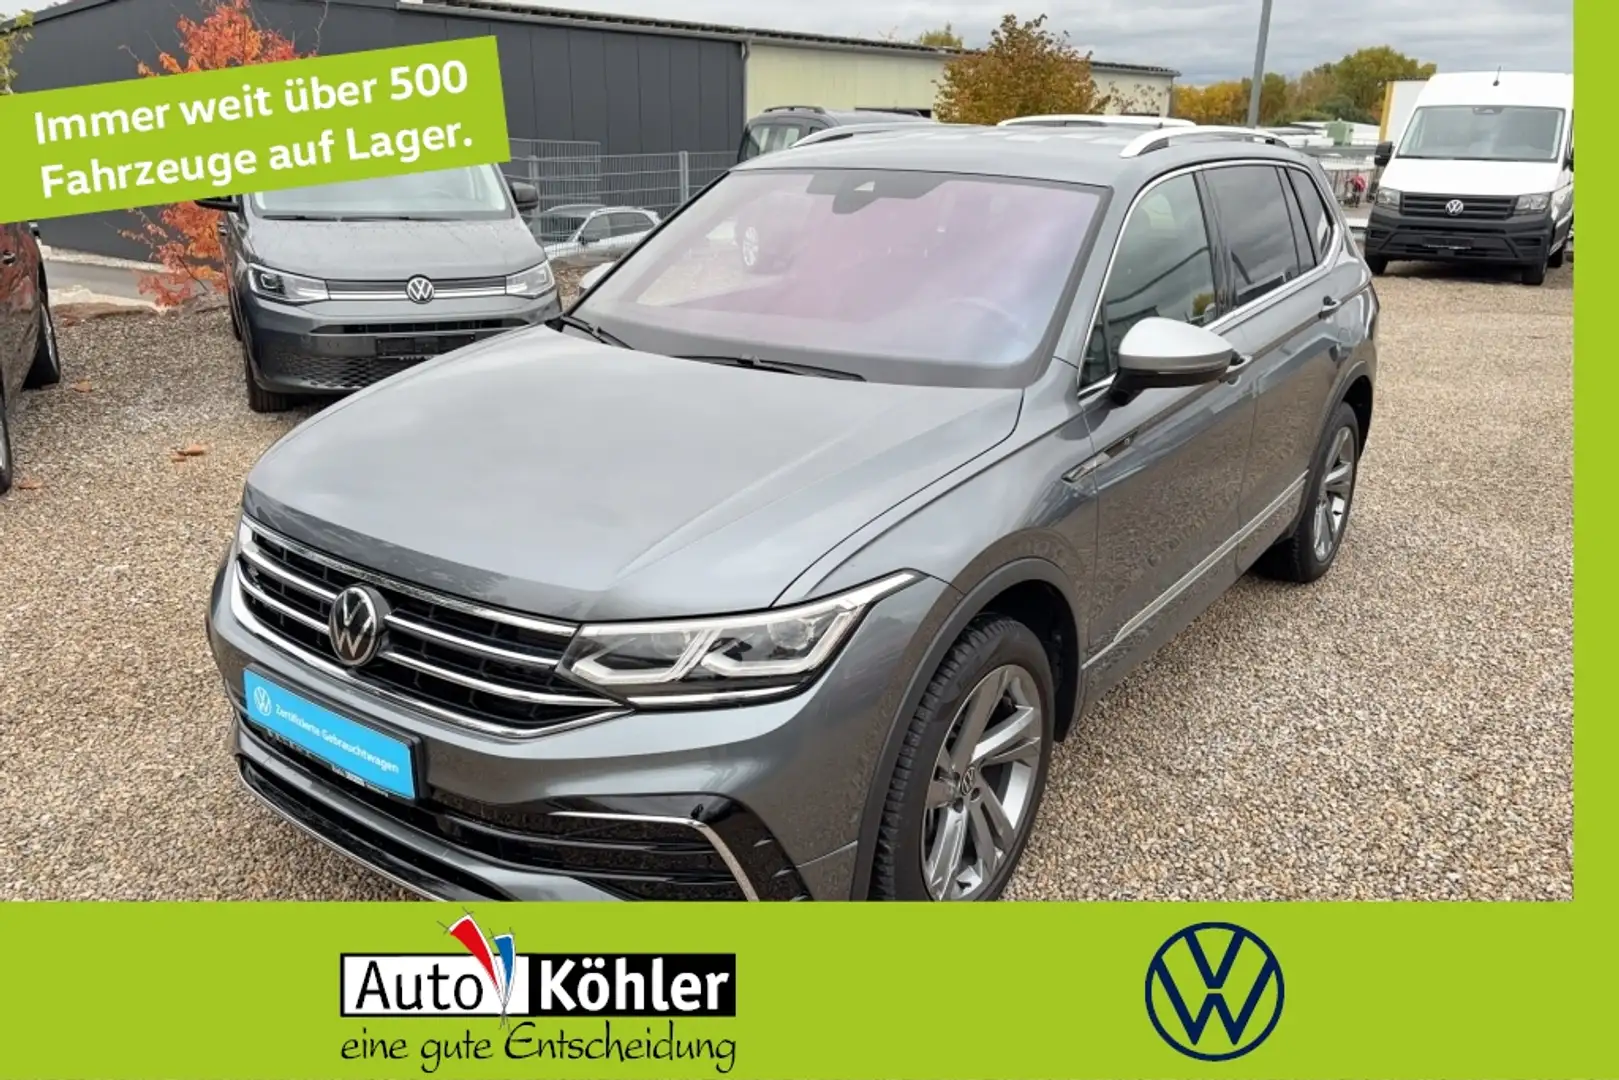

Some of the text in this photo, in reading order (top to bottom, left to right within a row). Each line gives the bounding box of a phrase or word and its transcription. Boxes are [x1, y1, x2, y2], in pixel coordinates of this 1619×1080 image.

[1445, 199, 1464, 216] VW
[406, 276, 435, 305] VW
[329, 586, 378, 666] VW
[253, 685, 272, 716] VW
[320, 727, 400, 775] Gebrauchtwagen
